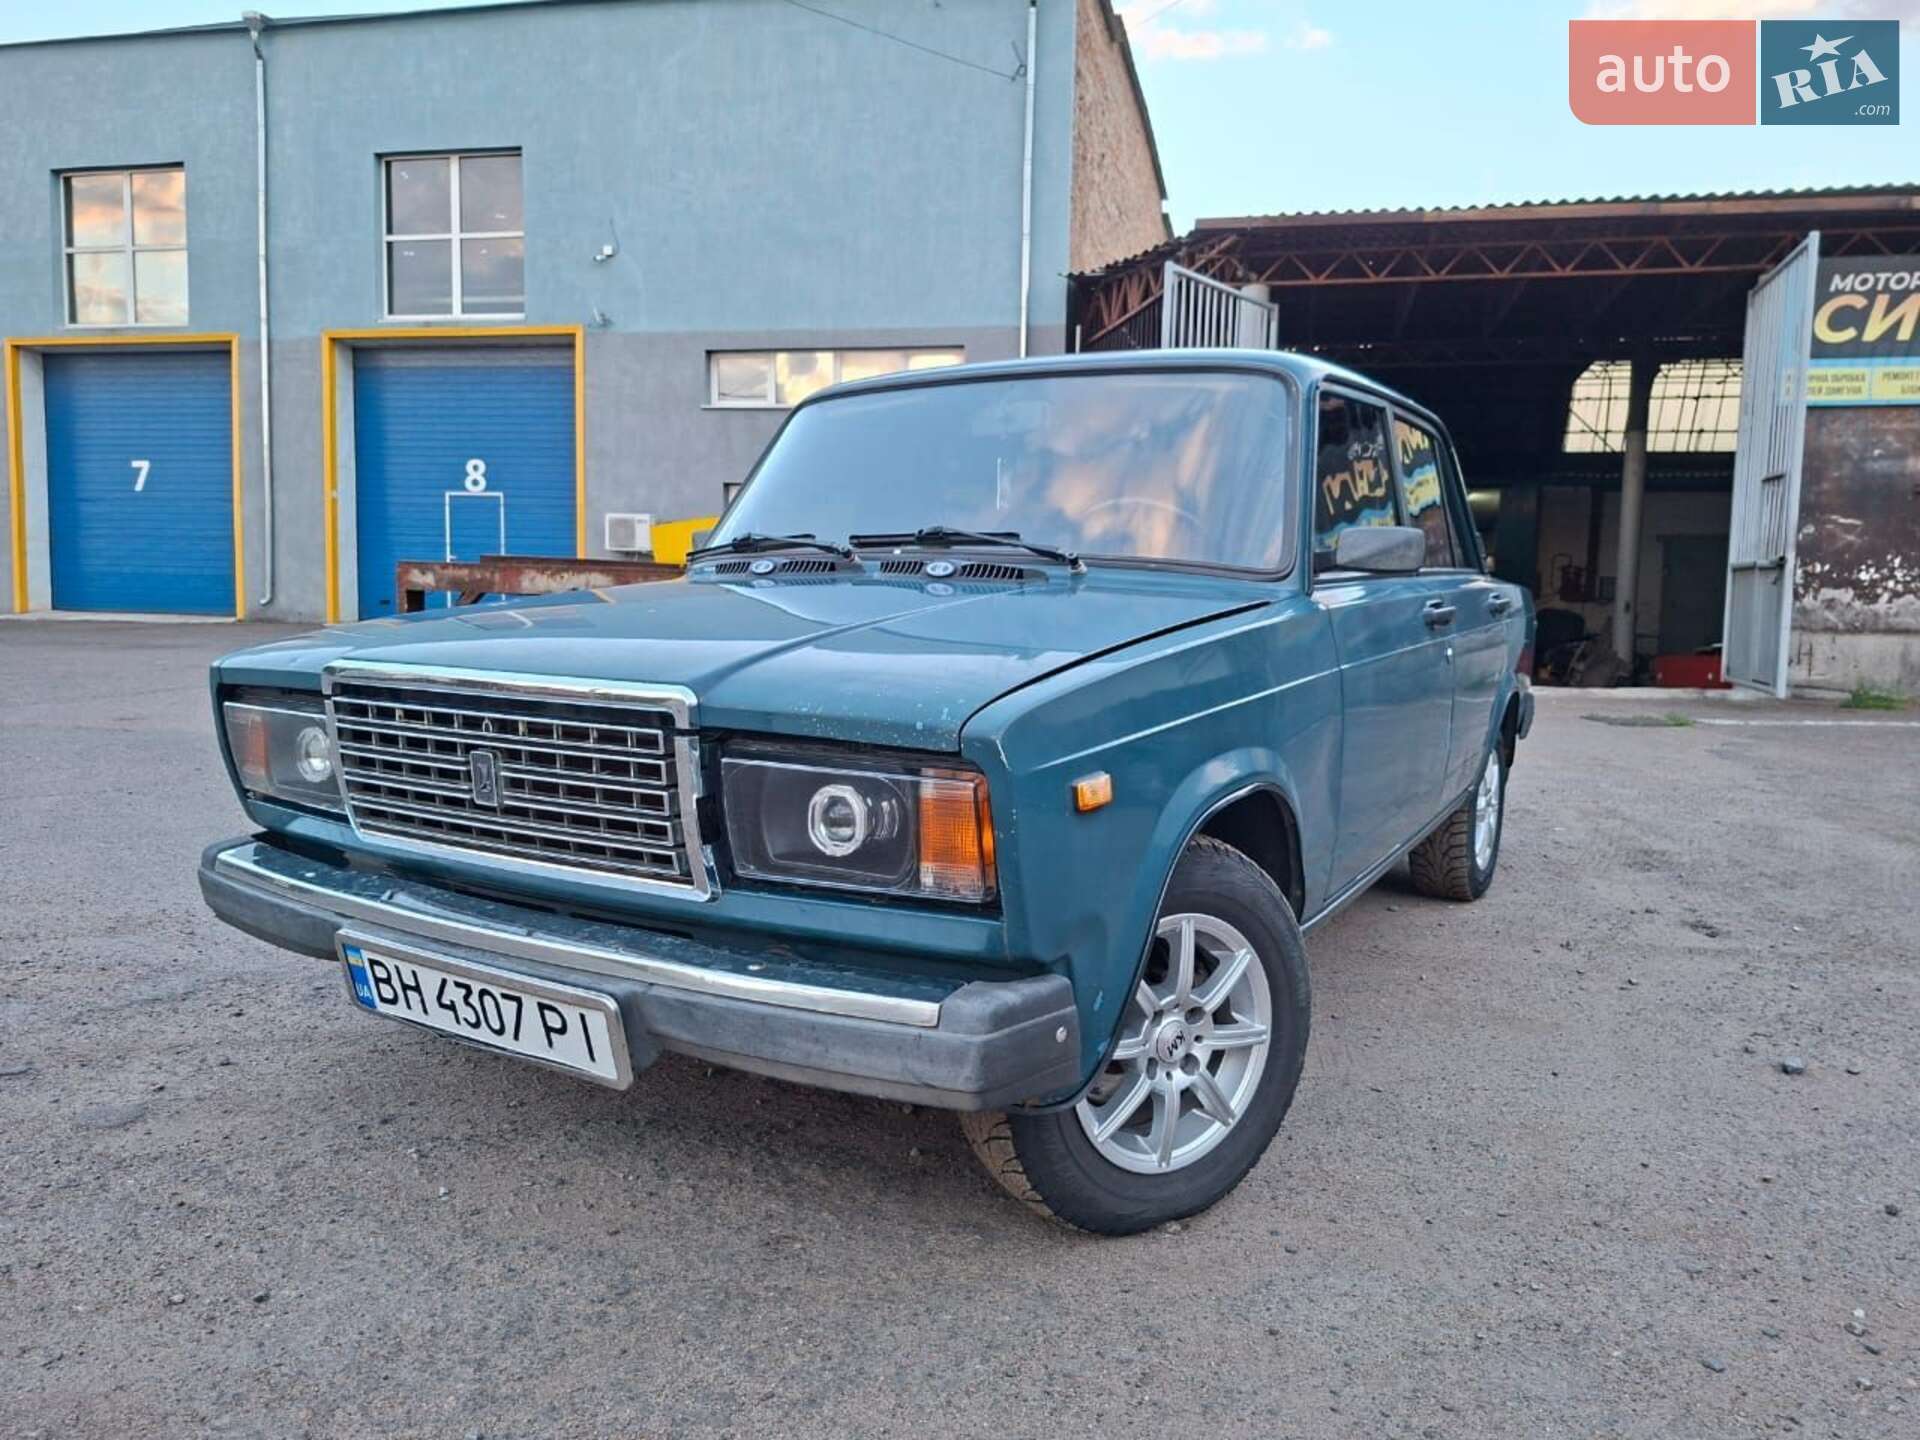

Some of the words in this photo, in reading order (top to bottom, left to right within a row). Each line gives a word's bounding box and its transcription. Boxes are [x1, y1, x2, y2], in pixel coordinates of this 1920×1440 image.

[131, 460, 151, 492] 7
[464, 458, 487, 493] 8
[355, 982, 373, 1000] UA
[367, 957, 429, 1016] BH
[436, 977, 523, 1041] 4307
